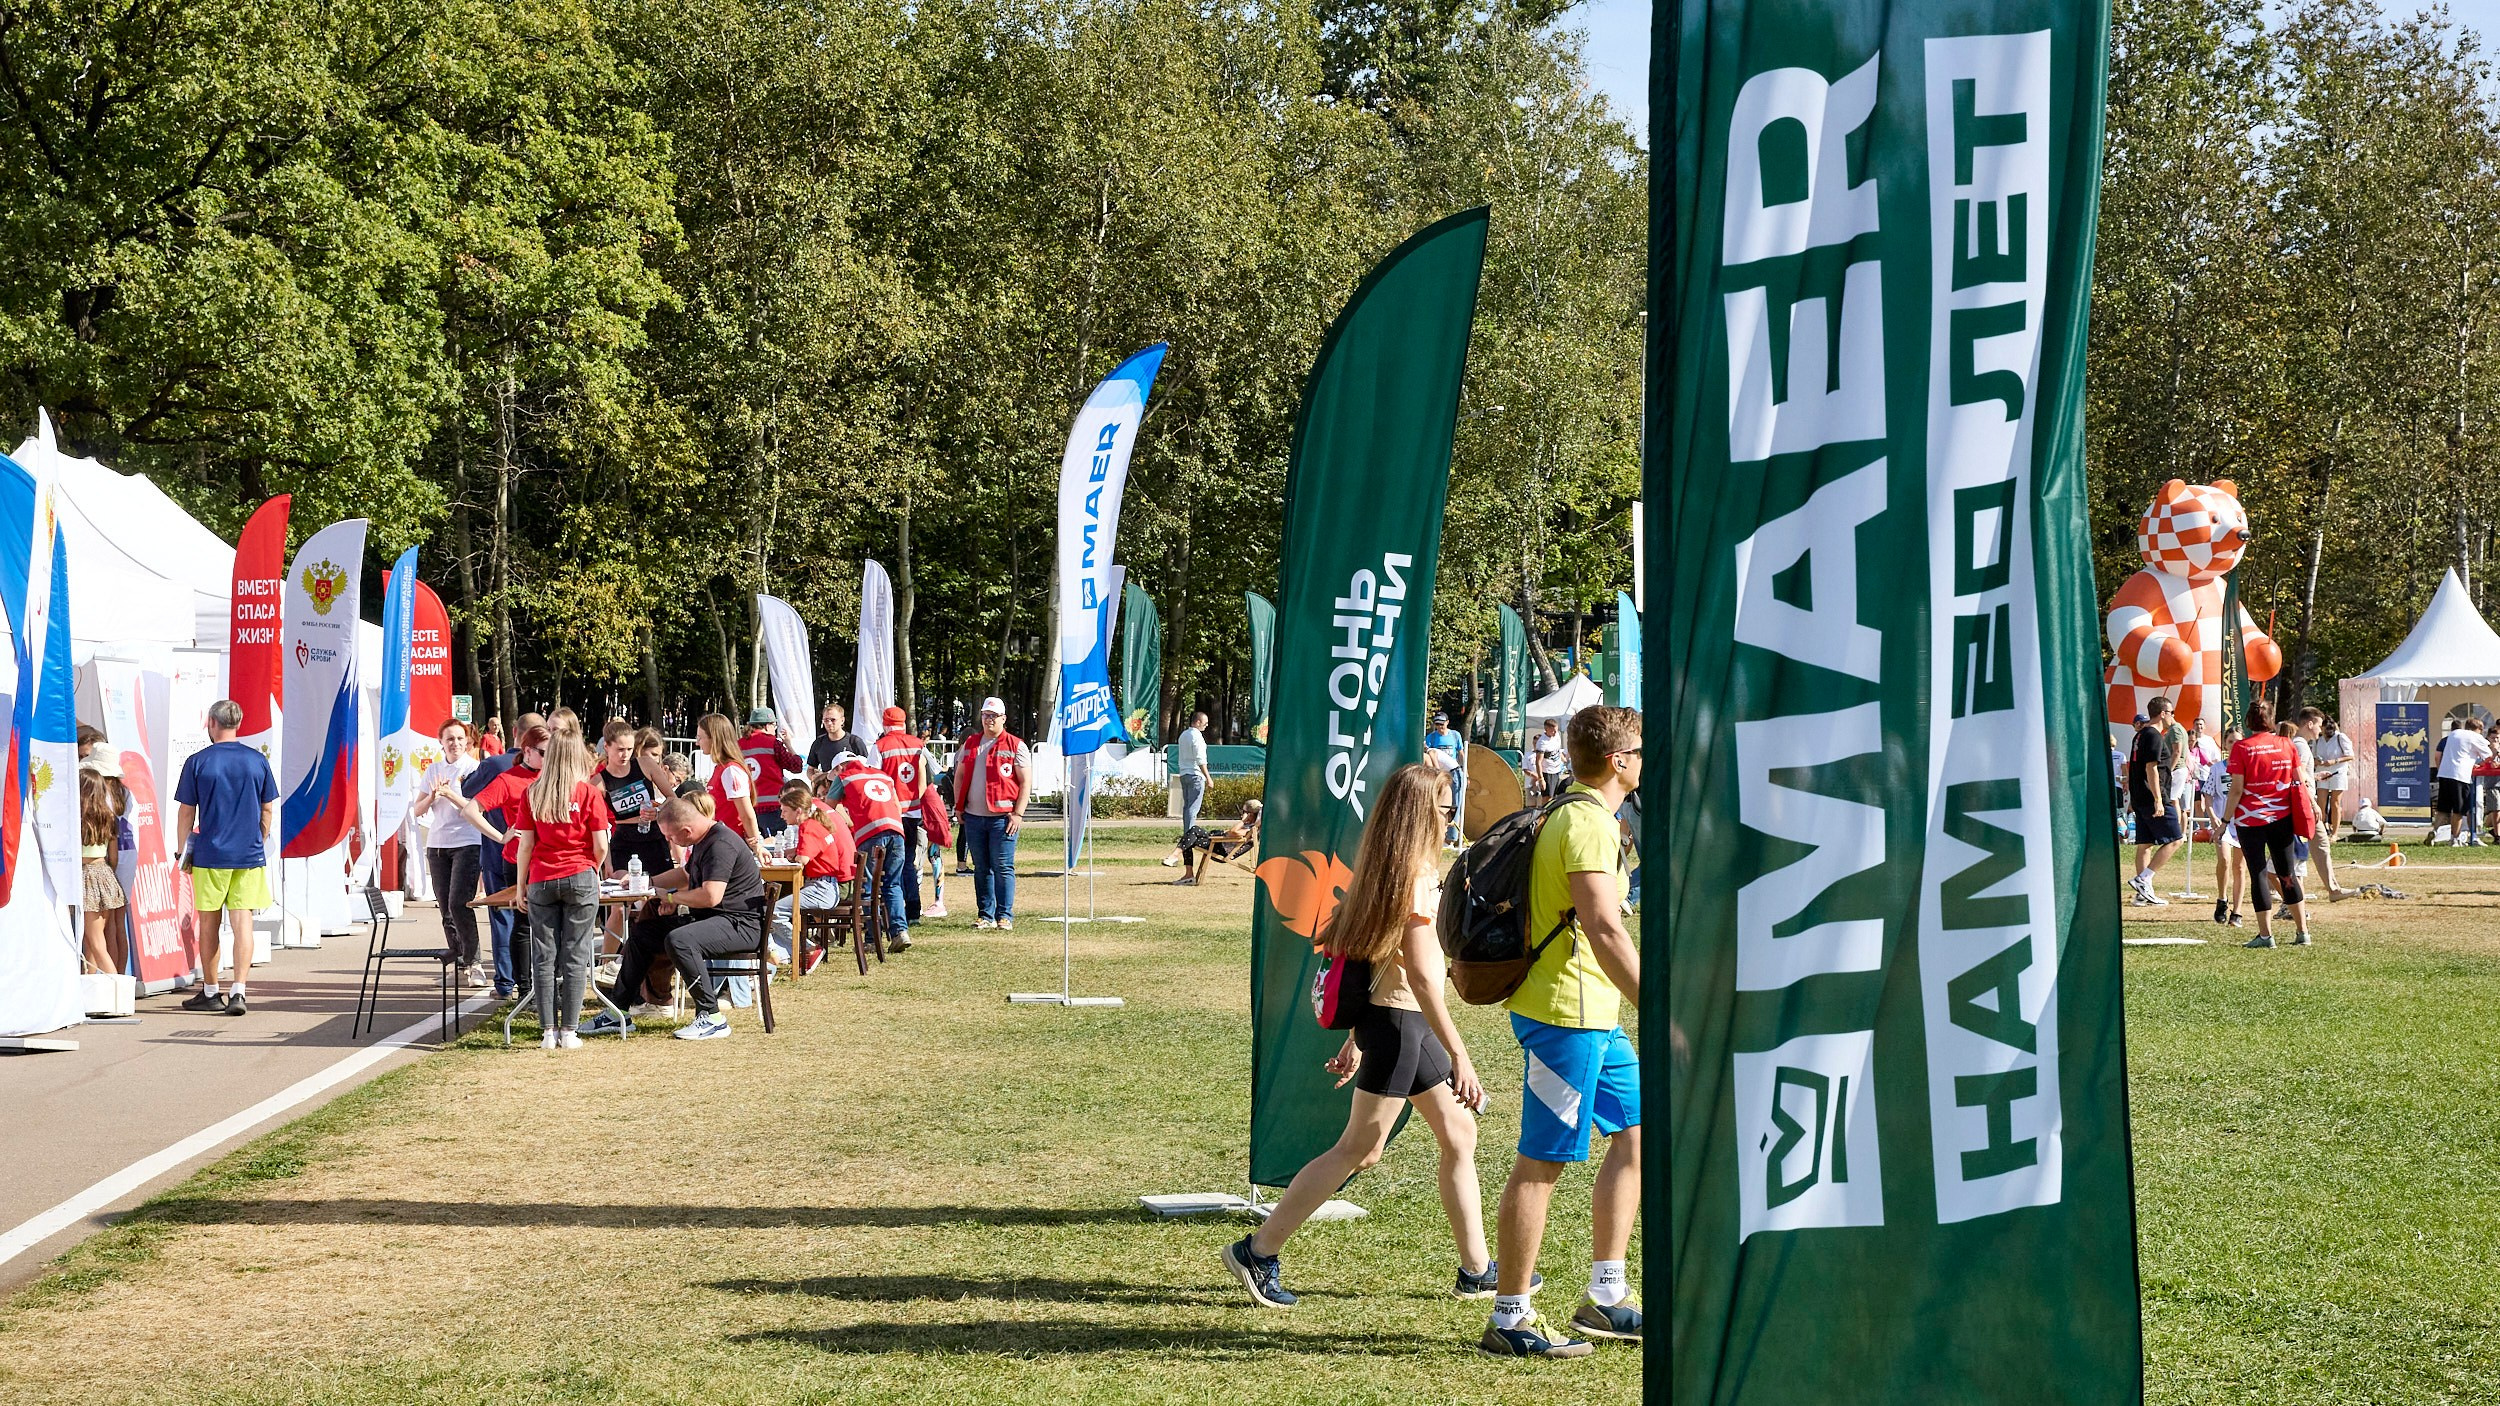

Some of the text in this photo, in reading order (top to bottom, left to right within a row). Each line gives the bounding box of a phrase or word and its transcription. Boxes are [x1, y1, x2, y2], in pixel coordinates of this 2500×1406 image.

[1082, 423, 1121, 568] MAER
[1722, 50, 1887, 991] MAER
[237, 579, 279, 596] ВМЕСТ
[237, 603, 276, 620] СПАСА
[237, 627, 275, 644] ЖИЗН
[412, 630, 439, 641] ЕСТЕ
[1940, 79, 2037, 1182] НАМ 20 ЛЕТ
[311, 648, 337, 657] СЛУЖБА
[411, 647, 447, 658] АСАЕМ
[400, 648, 409, 691] ПРОЖИТЬ
[410, 664, 442, 675] ИЗНИ!
[1325, 568, 1376, 800] ОГОНЬ
[2222, 636, 2234, 731] MPAC
[2231, 654, 2243, 731] АГОТВОРИТЕЛЬНЫЙ
[620, 793, 645, 809] 449
[1494, 1305, 1524, 1315] КРОВАТЬ
